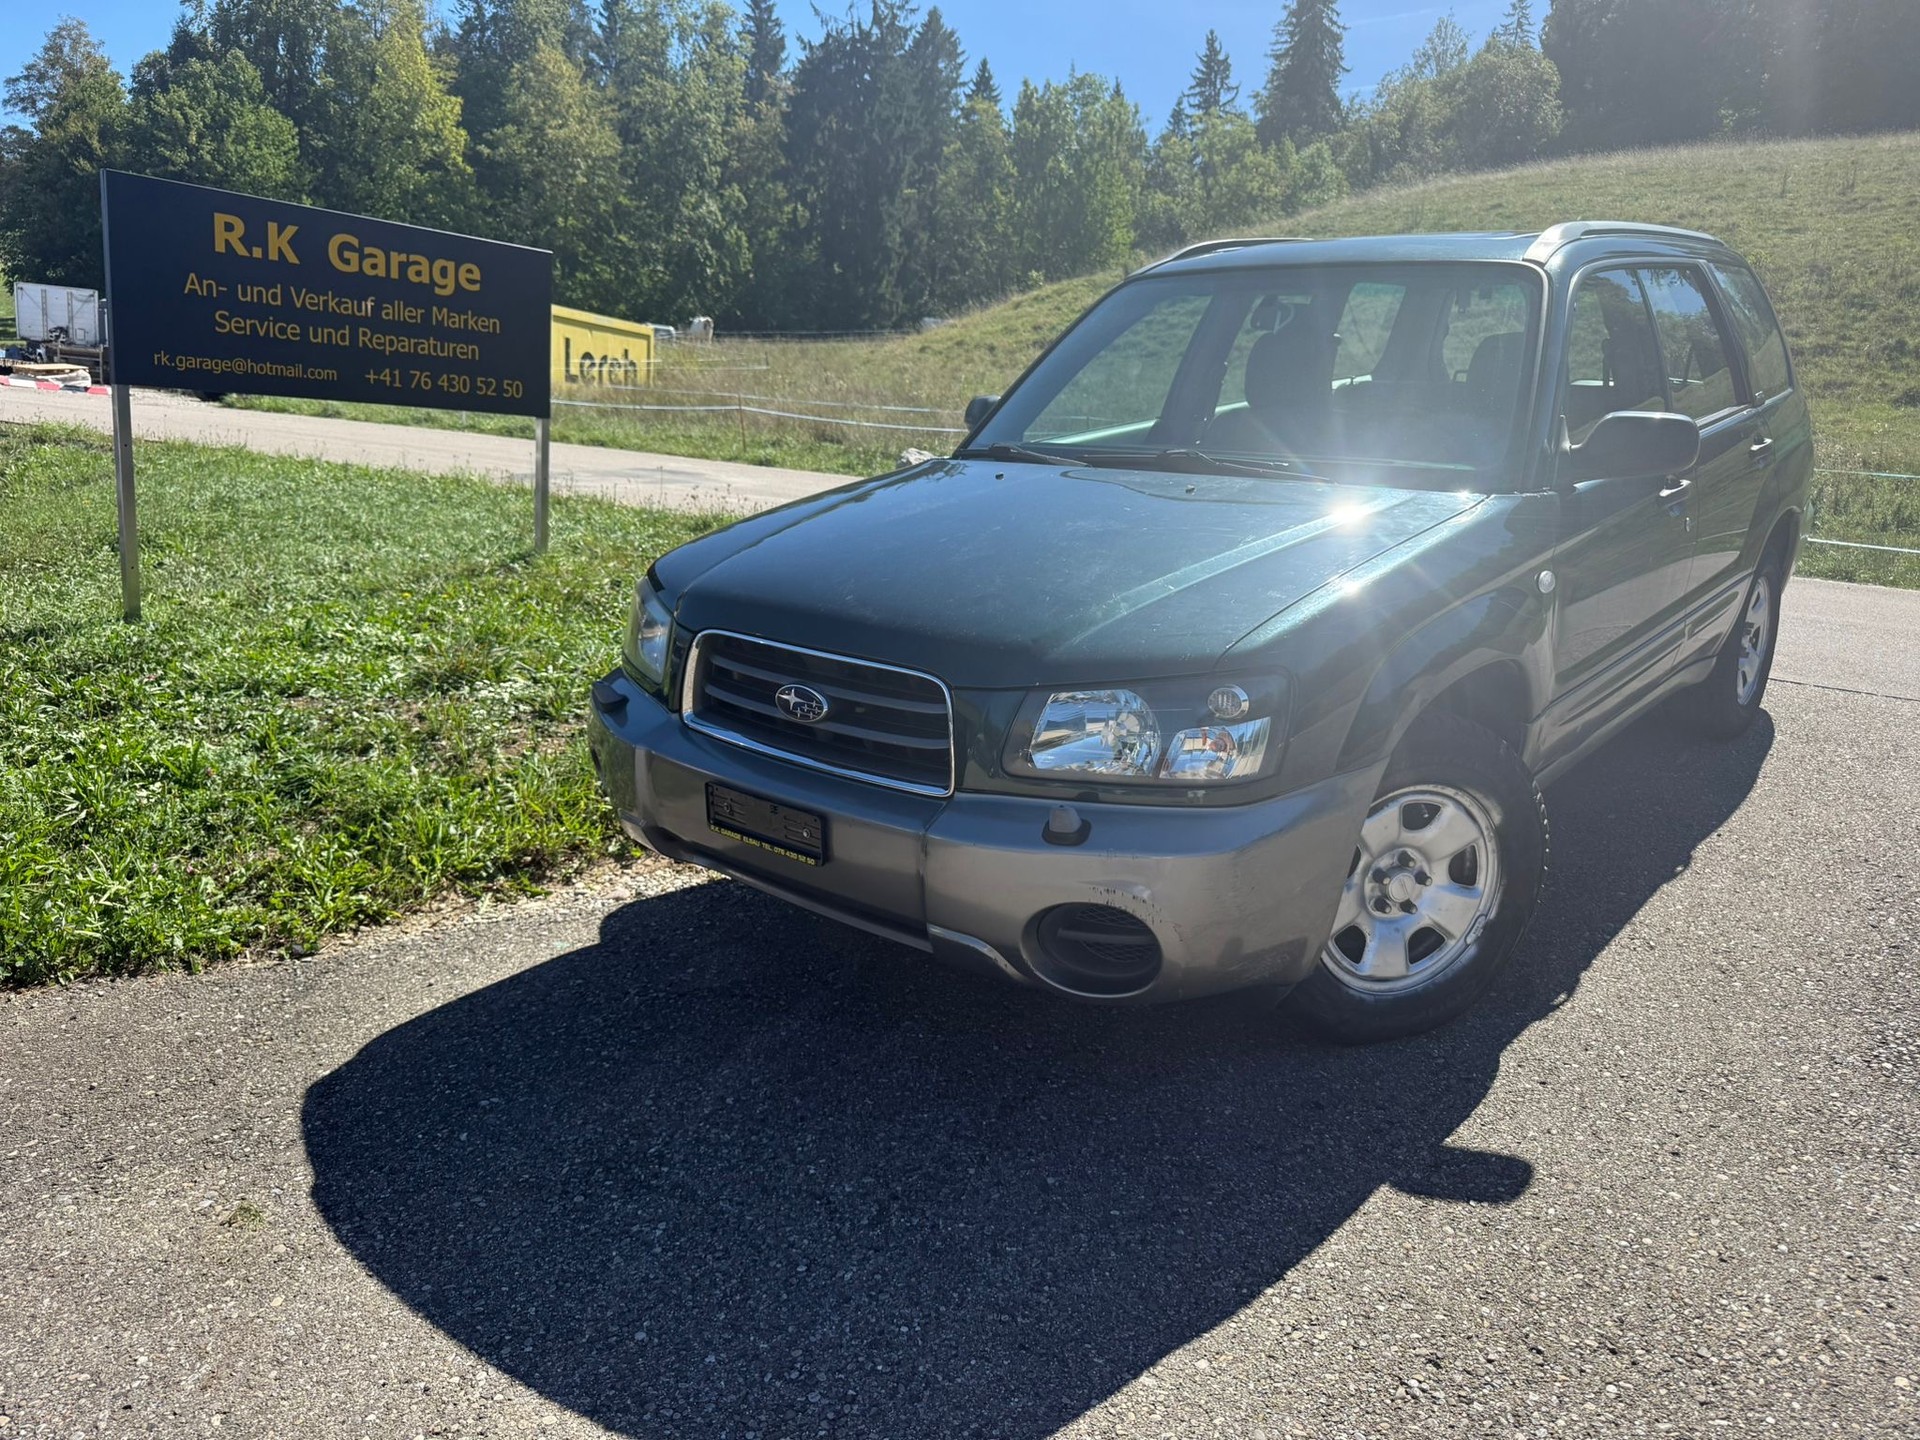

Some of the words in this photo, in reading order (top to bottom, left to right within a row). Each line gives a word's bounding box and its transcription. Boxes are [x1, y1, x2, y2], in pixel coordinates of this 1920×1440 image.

[213, 212, 300, 264] R.K
[327, 233, 481, 296] Garage
[184, 272, 228, 298] An-
[237, 283, 282, 306] und
[290, 286, 375, 317] Verkauf
[381, 300, 425, 324] aller
[432, 306, 501, 334] Marken
[215, 310, 300, 341] Service
[309, 325, 350, 346] und
[358, 327, 480, 361] Reparaturen
[153, 350, 338, 381] rk.garage@hotmail.com
[365, 368, 402, 388] +41
[409, 370, 432, 390] 76
[437, 373, 470, 394] 430
[476, 377, 497, 396] 52
[503, 380, 523, 399] 50
